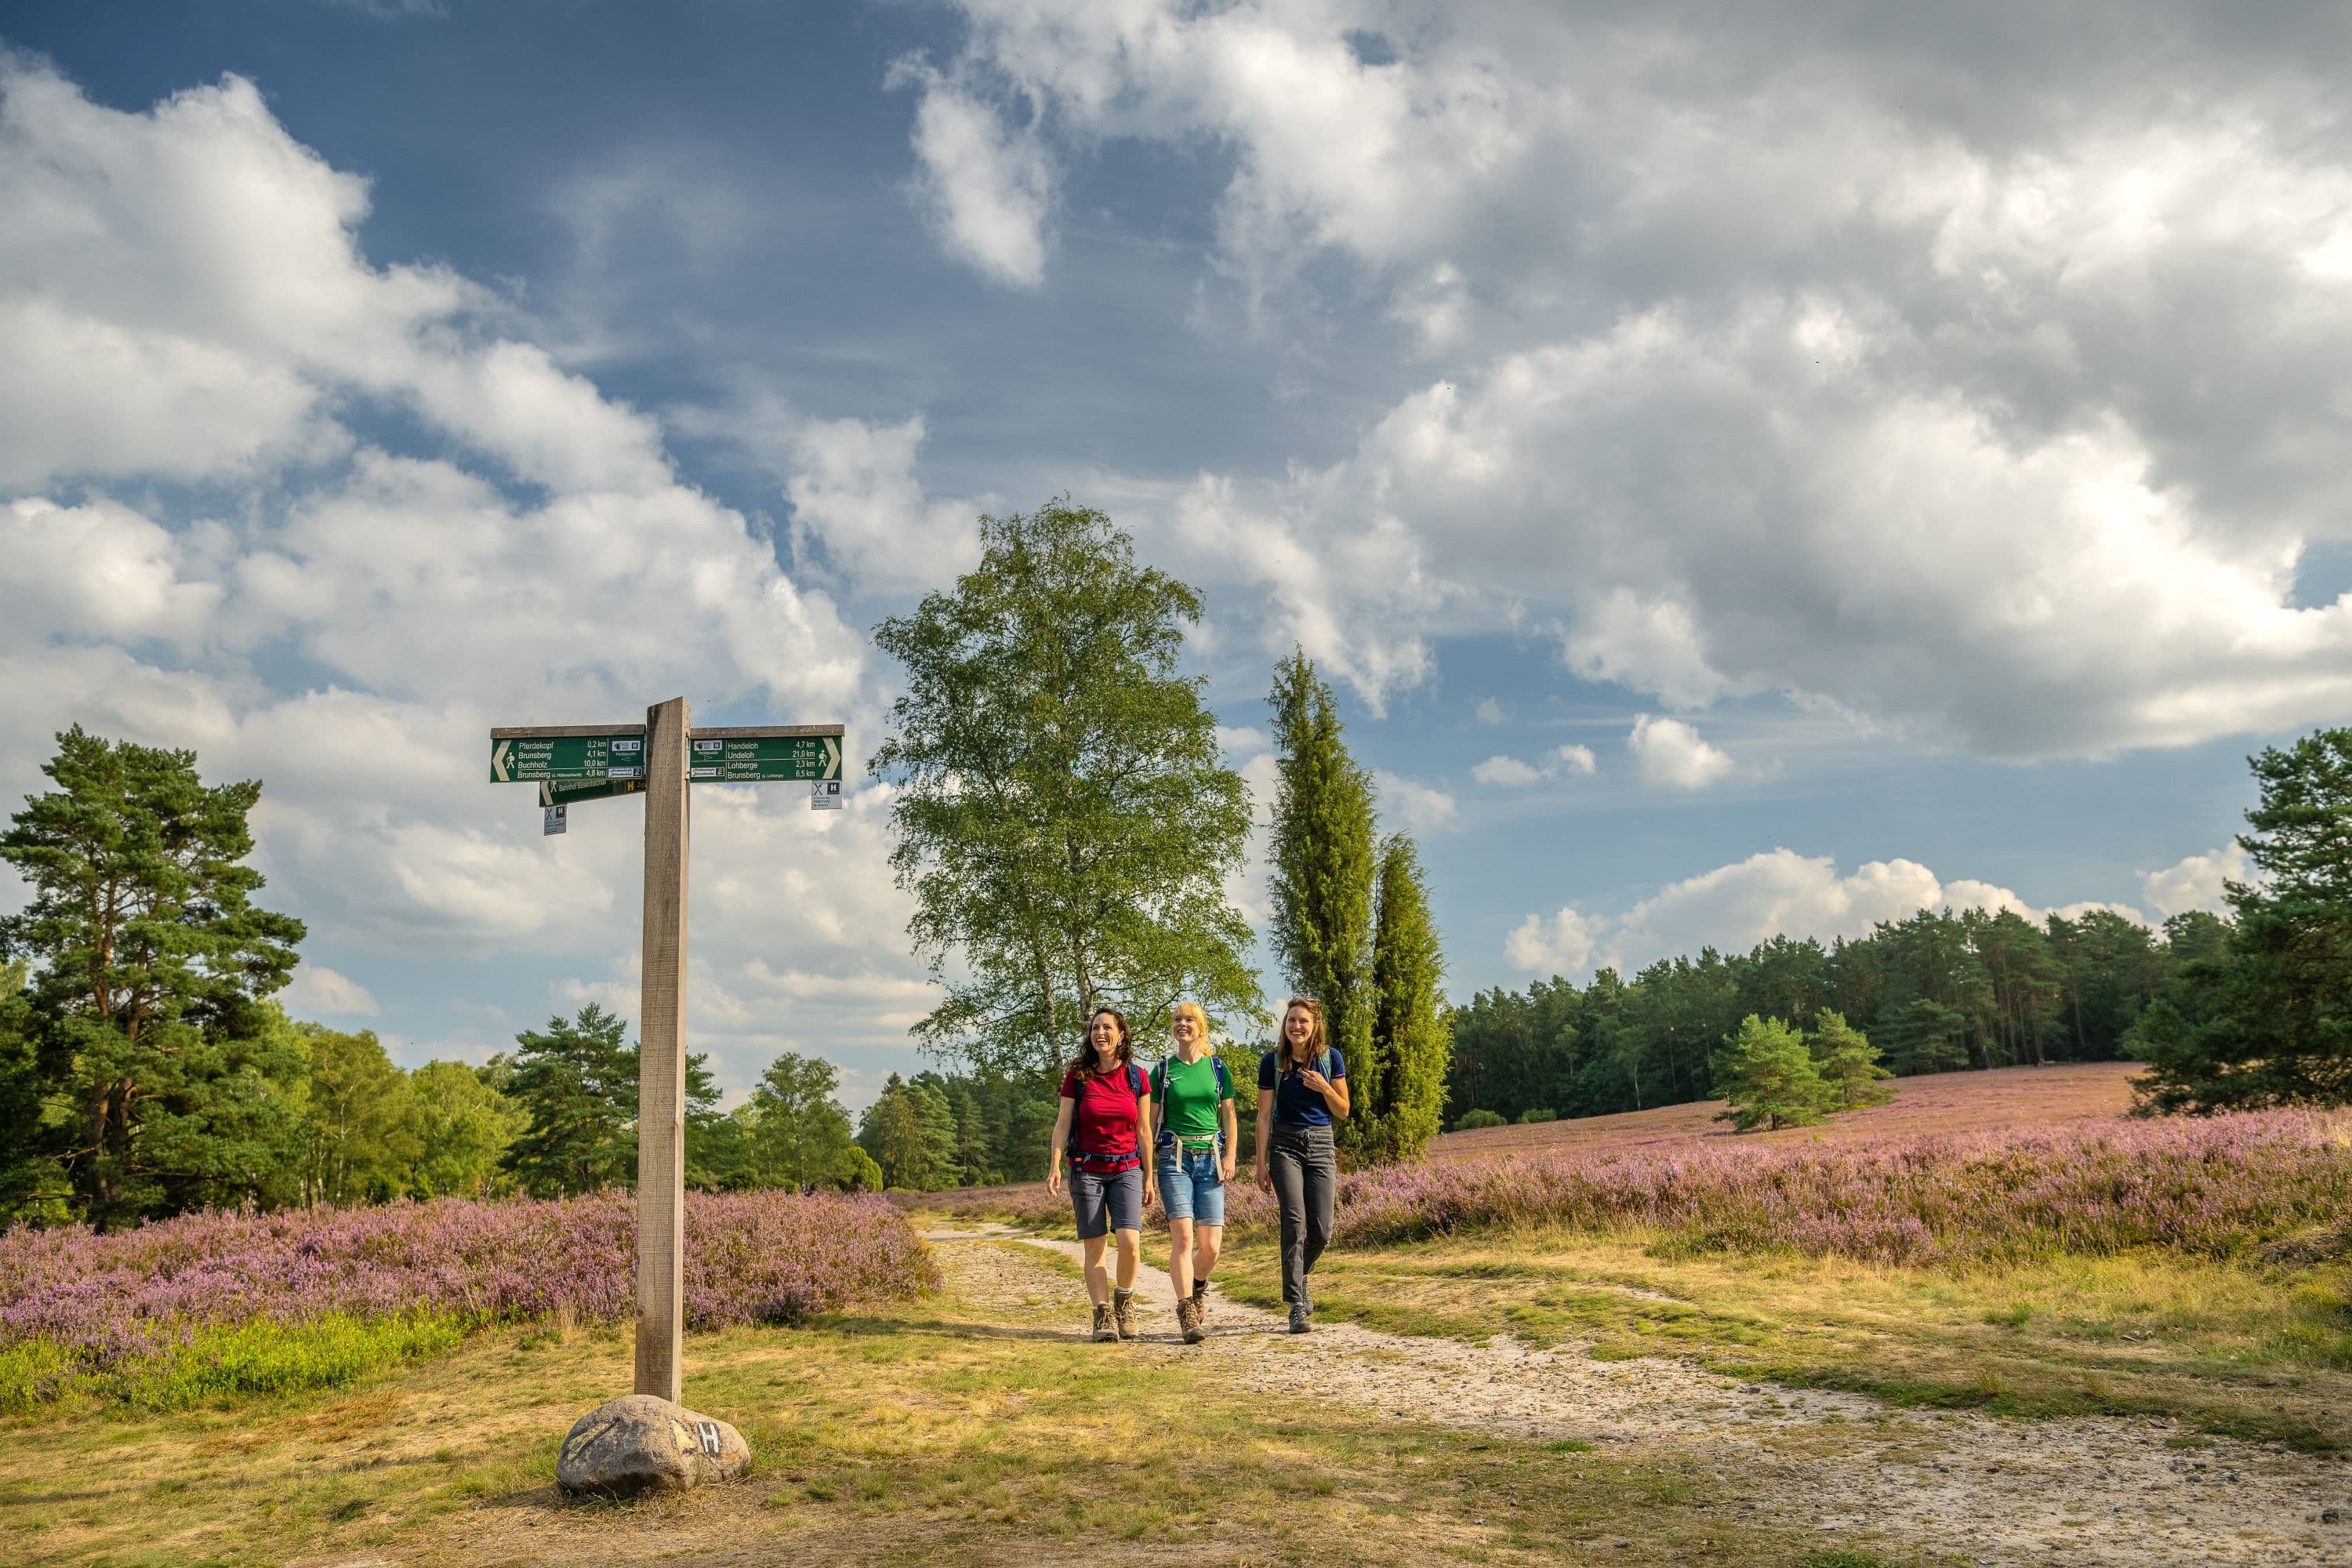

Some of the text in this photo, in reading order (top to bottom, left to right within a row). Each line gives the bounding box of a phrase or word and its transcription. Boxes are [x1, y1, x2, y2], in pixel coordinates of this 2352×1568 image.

[519, 742, 554, 750] Pferdekopf
[796, 760, 806, 768] 2,3
[517, 771, 550, 779] Brunsberg
[728, 771, 760, 780] Brunsberg
[627, 781, 633, 791] H
[699, 1422, 719, 1453] H
